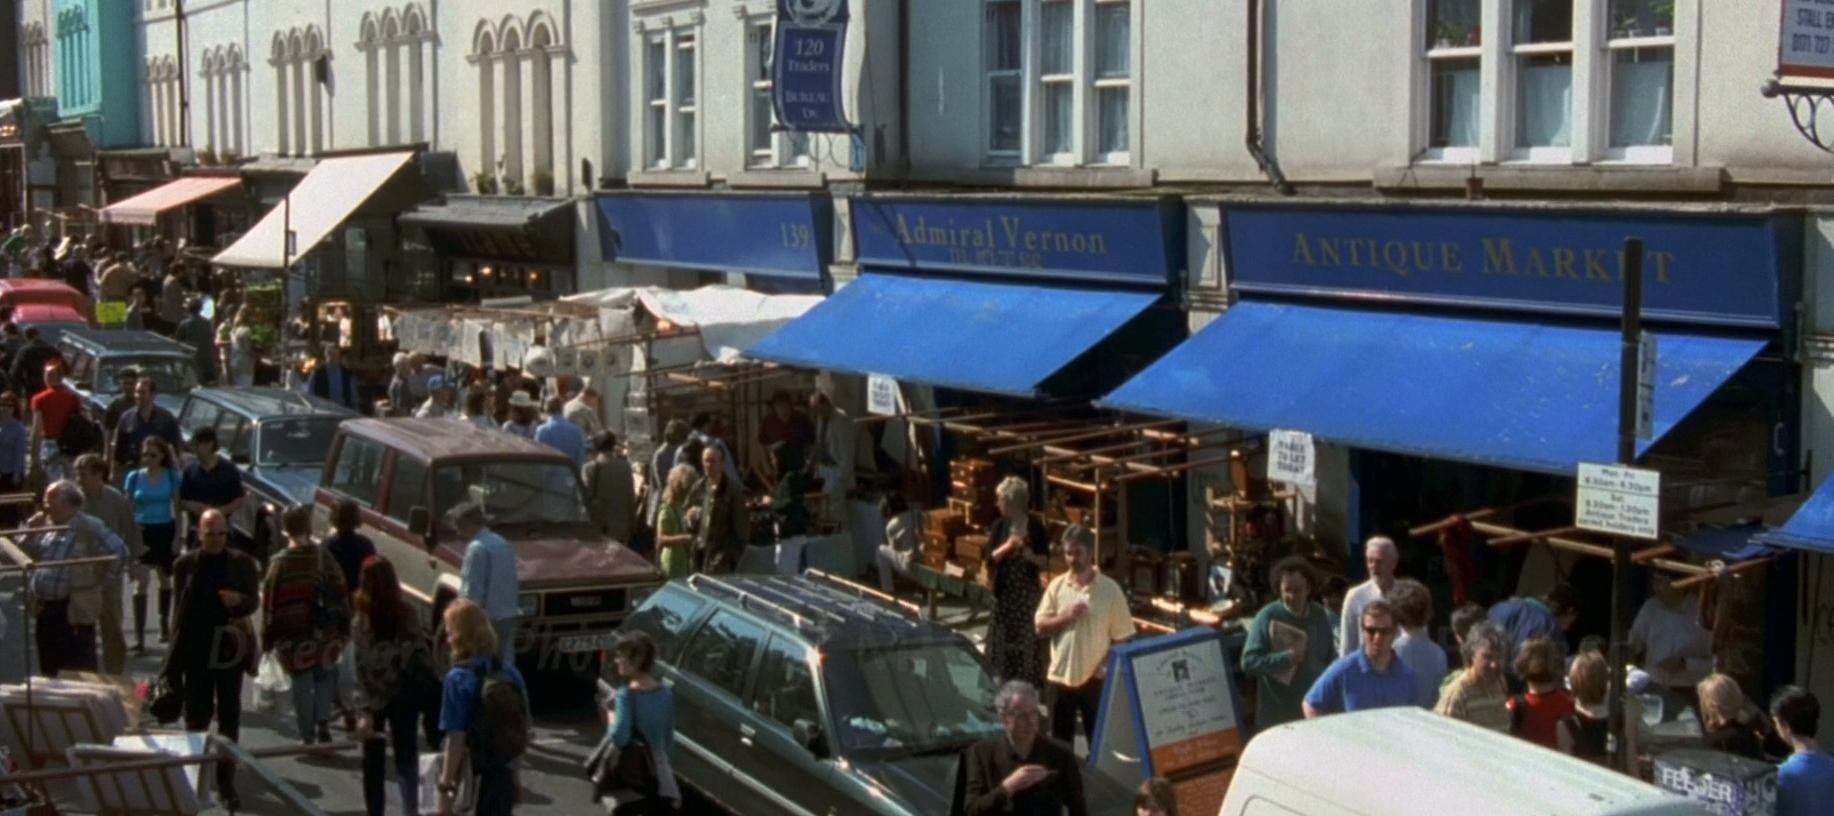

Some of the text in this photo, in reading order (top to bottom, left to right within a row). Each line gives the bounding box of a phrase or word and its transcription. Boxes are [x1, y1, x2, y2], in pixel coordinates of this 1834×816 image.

[795, 38, 825, 58] 120
[787, 59, 830, 73] Traders
[780, 222, 809, 248] 139
[896, 213, 1107, 254] Admiral Vernon
[1291, 232, 1464, 278] ANTIQUE
